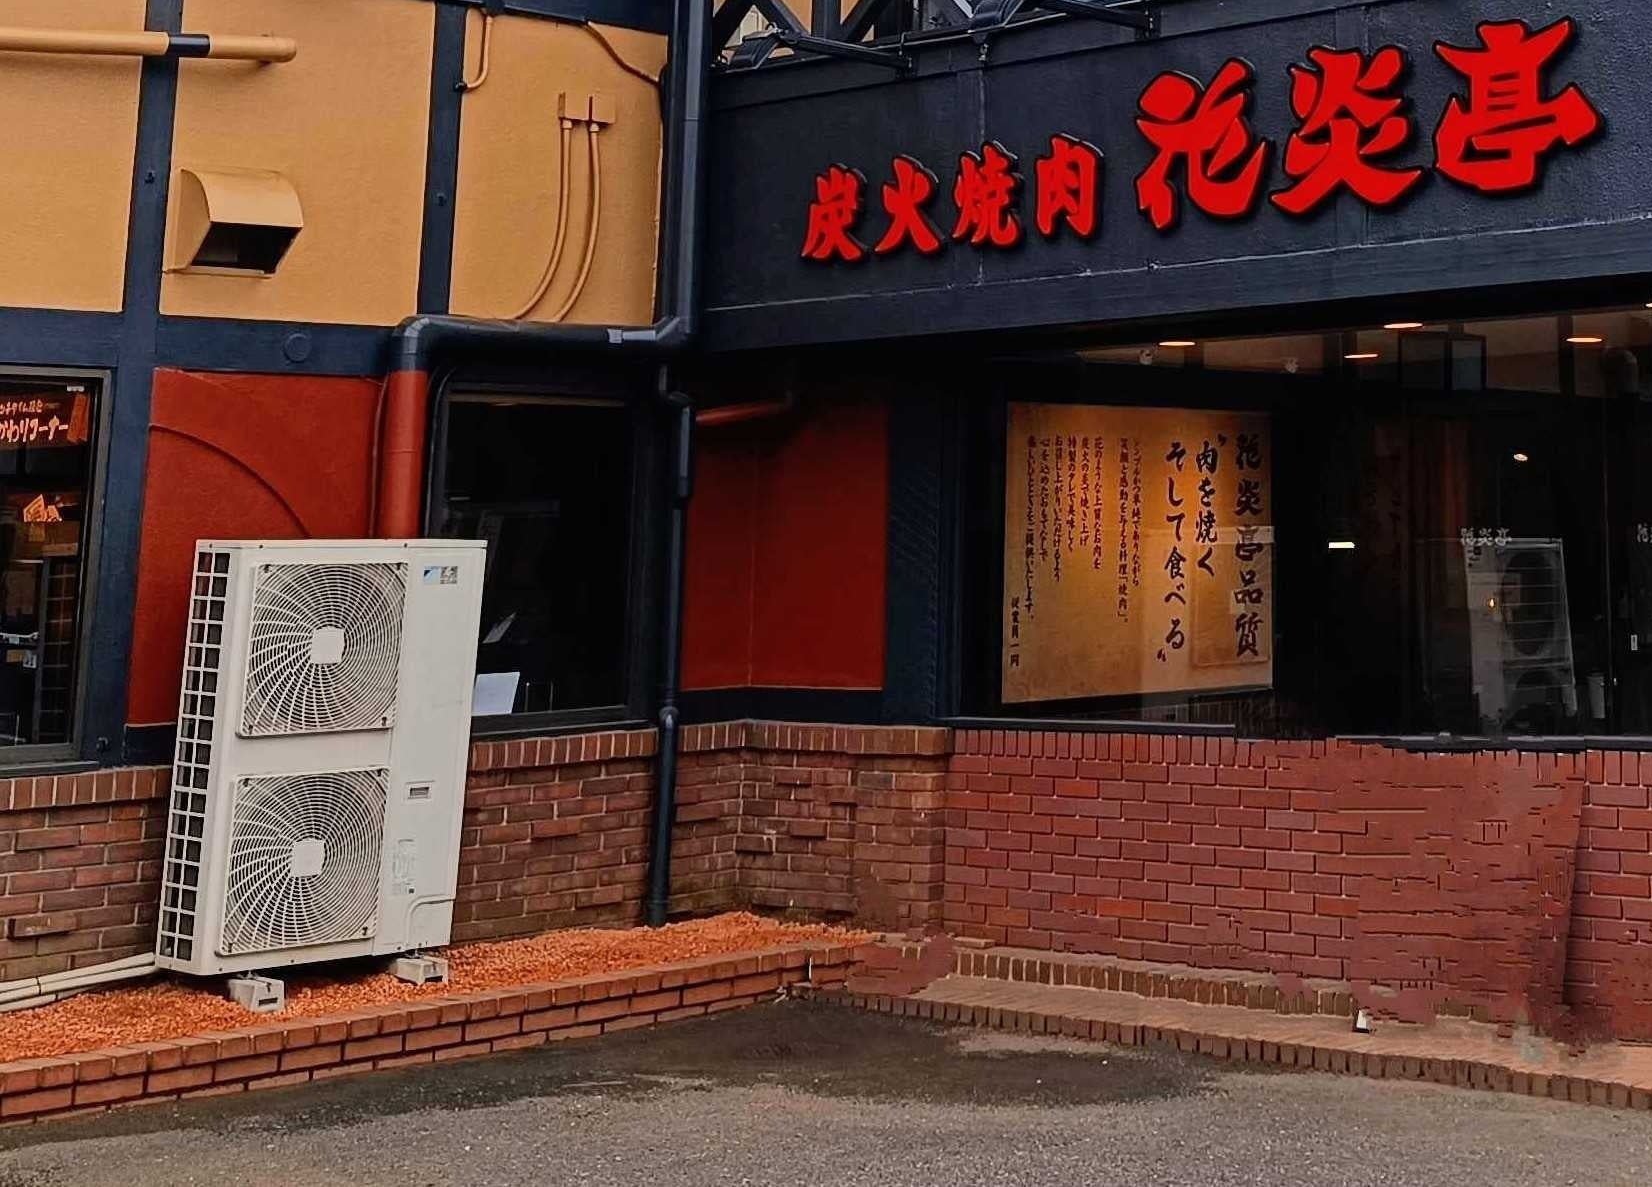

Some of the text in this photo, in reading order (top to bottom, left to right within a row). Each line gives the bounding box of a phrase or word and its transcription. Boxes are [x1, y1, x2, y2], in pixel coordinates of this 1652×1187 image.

[801, 16, 1603, 263] 炭火焼肉 花炎亭
[1234, 433, 1264, 657] 花炎亭品質
